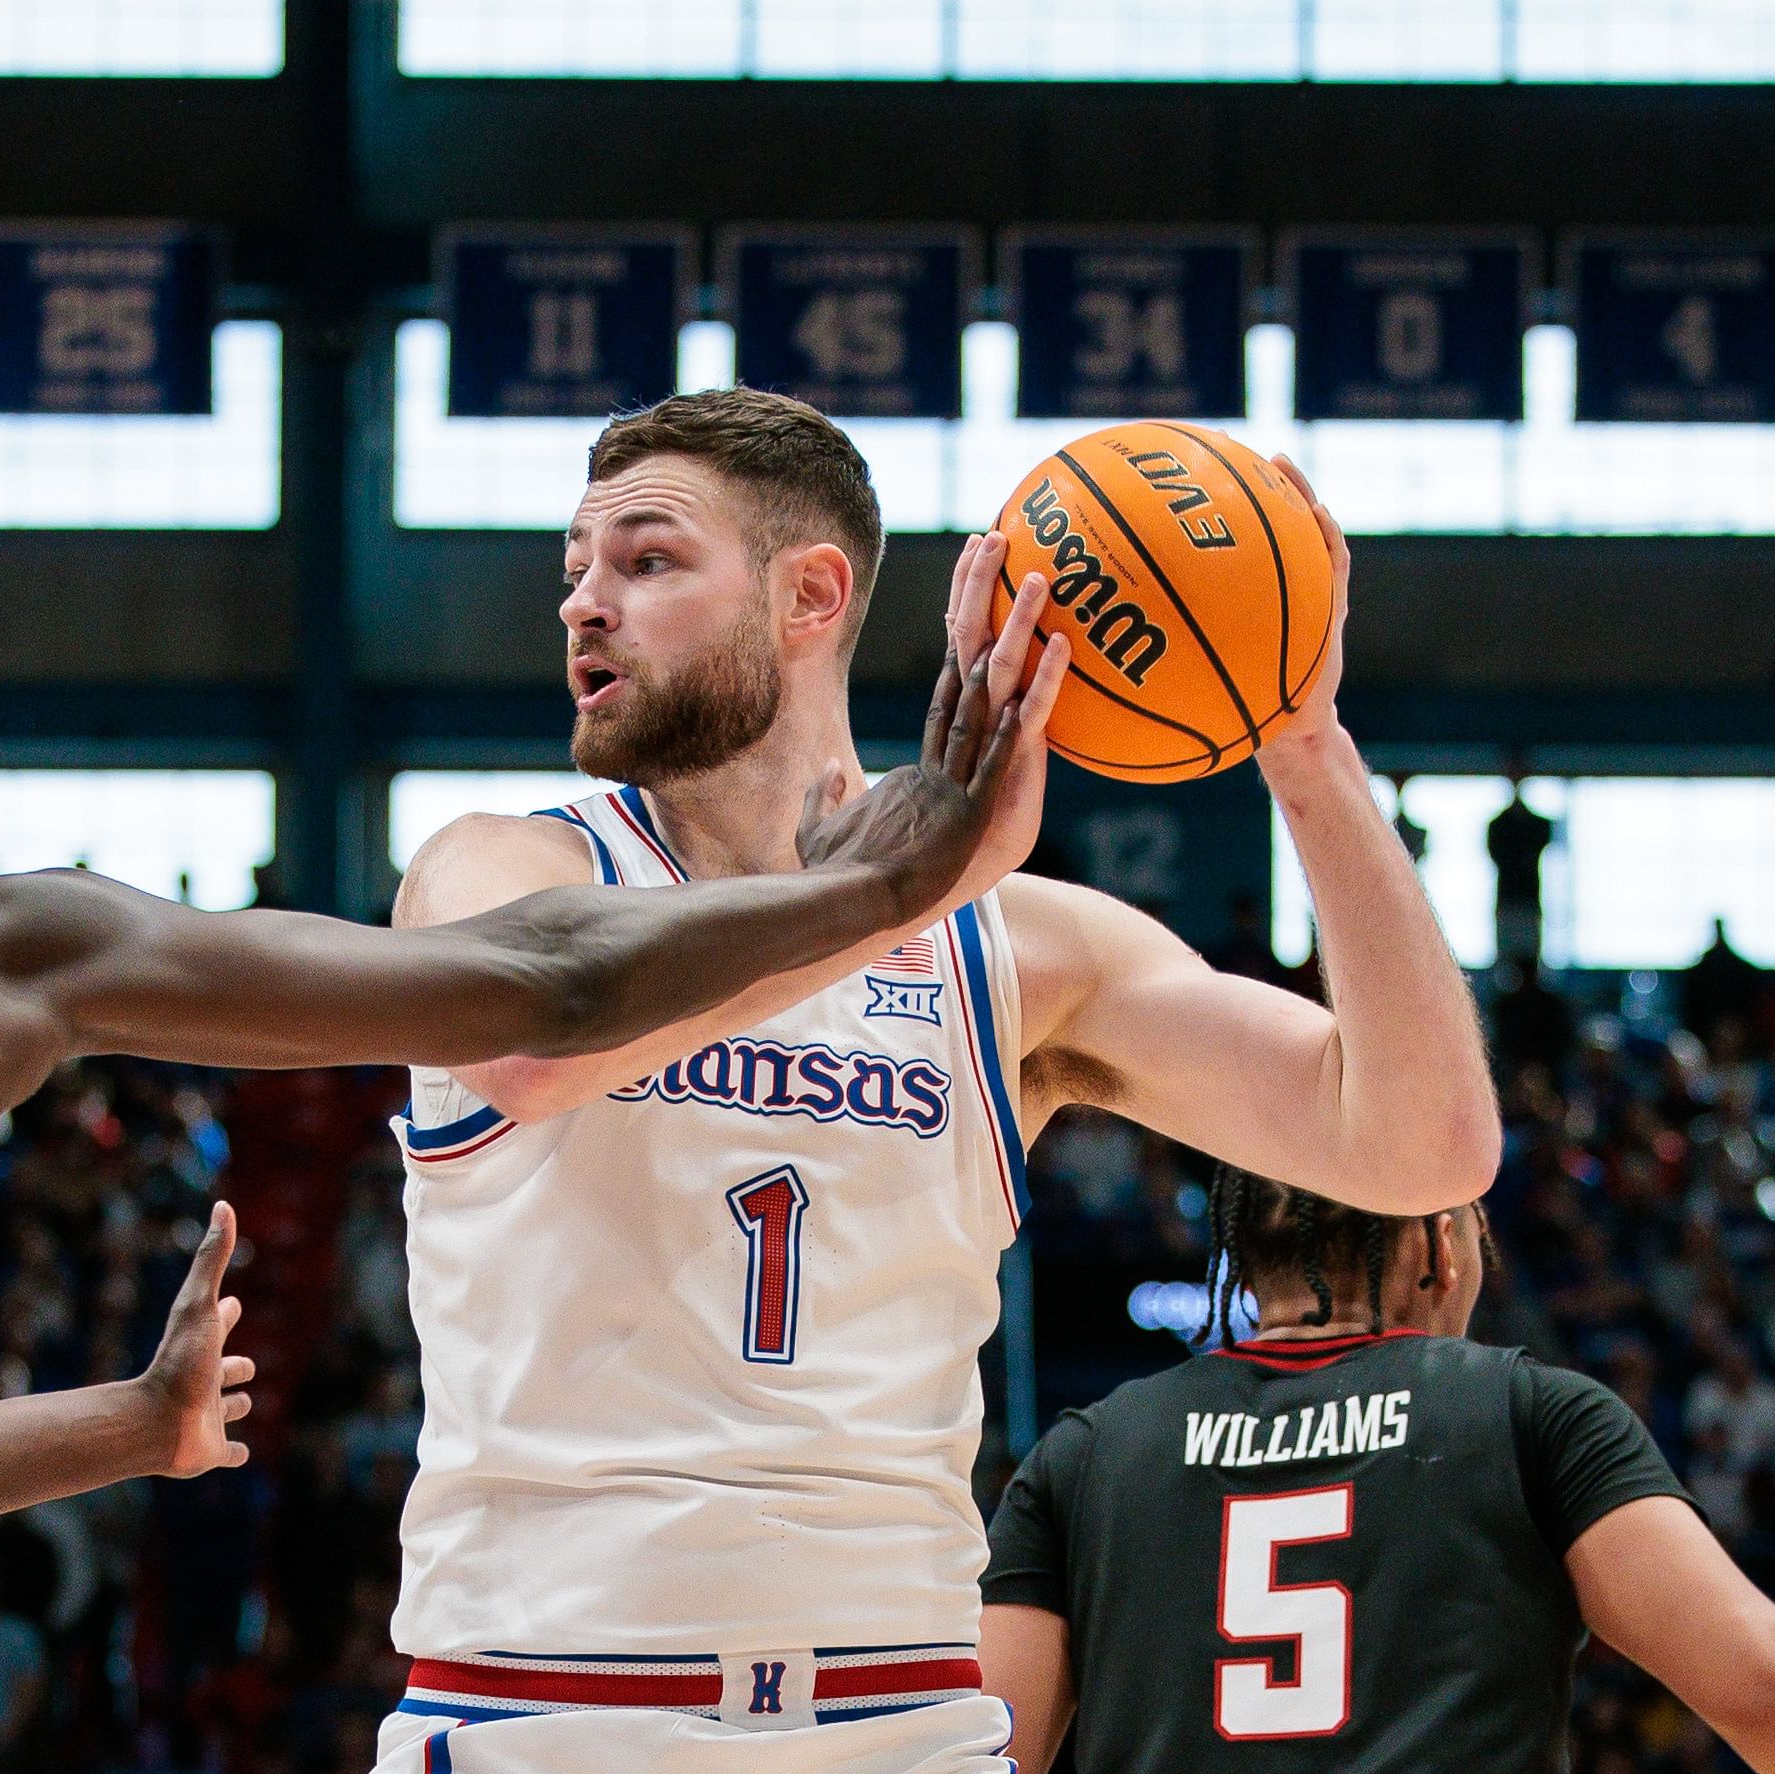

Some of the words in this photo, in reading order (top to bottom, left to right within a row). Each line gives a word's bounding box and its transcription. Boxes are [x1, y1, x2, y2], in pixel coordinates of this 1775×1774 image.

[36, 286, 157, 374] 25
[529, 290, 602, 377] 11
[791, 291, 908, 379] 45
[1071, 292, 1185, 381] 34
[1377, 293, 1442, 381] 0
[1661, 294, 1718, 385] 4
[1125, 450, 1238, 550] EVO
[1020, 472, 1169, 689] Wilson
[726, 1163, 810, 1365] 1
[1184, 1390, 1411, 1467] WILLIAMS
[1212, 1480, 1355, 1743] 5
